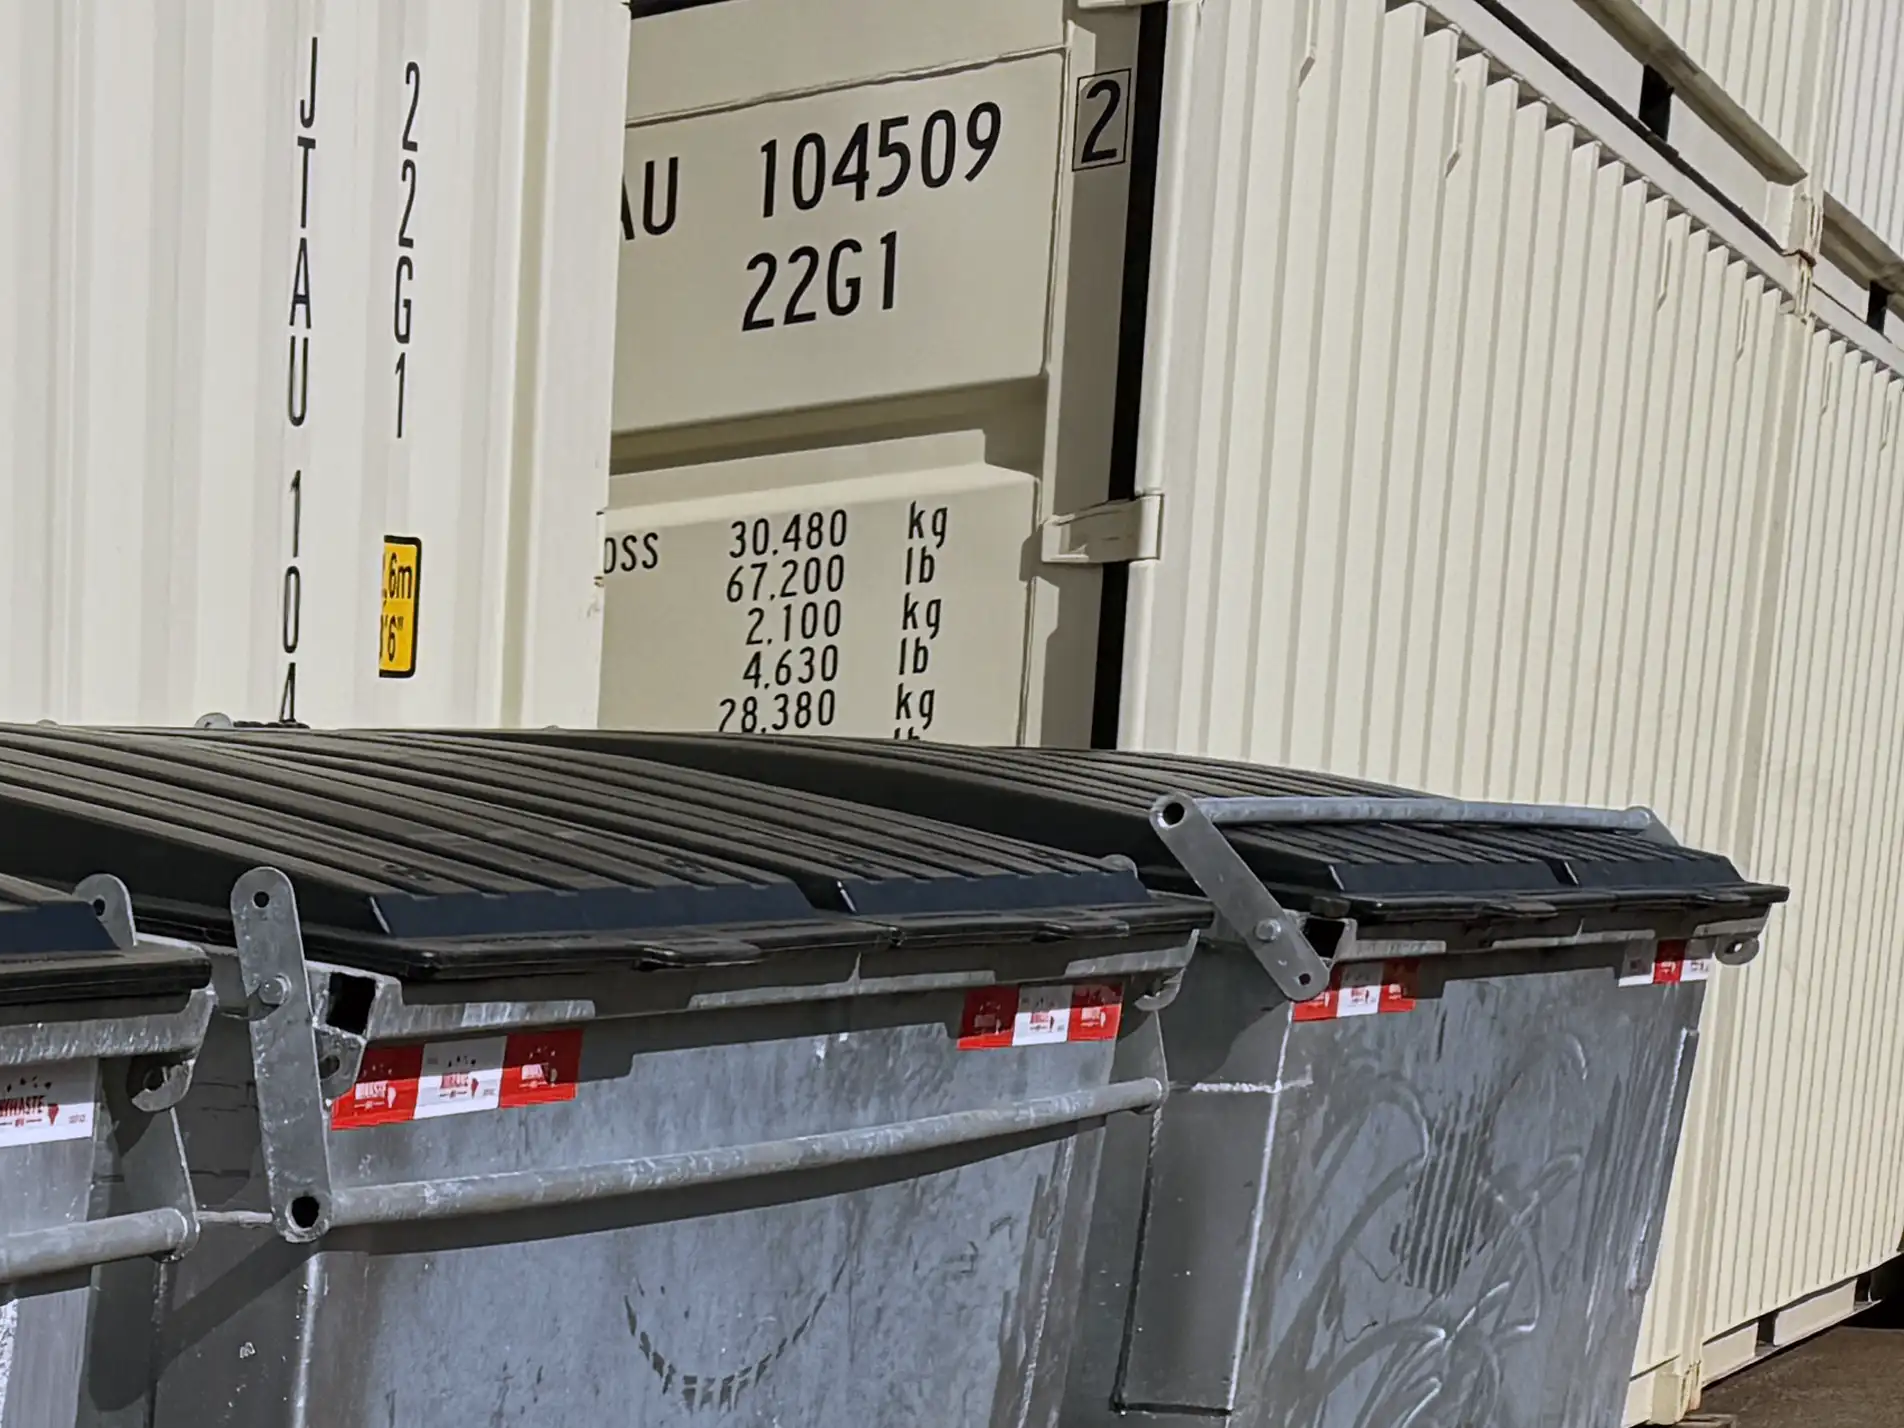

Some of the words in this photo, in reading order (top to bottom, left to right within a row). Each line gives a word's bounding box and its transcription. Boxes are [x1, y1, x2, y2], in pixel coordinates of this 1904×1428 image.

[760, 101, 1002, 218] 104509
[1080, 79, 1122, 164] 2
[289, 36, 318, 426] JTAU
[394, 60, 420, 438] 22G1
[742, 231, 897, 332] 22G1
[729, 509, 847, 559] 30.480
[907, 500, 948, 549] kg
[905, 546, 936, 586] lb
[745, 599, 842, 646] 2.100
[902, 593, 942, 640] kg
[742, 644, 839, 689] 4.630
[898, 637, 930, 676] lb
[718, 688, 836, 733] 28.380
[894, 683, 936, 730] kg
